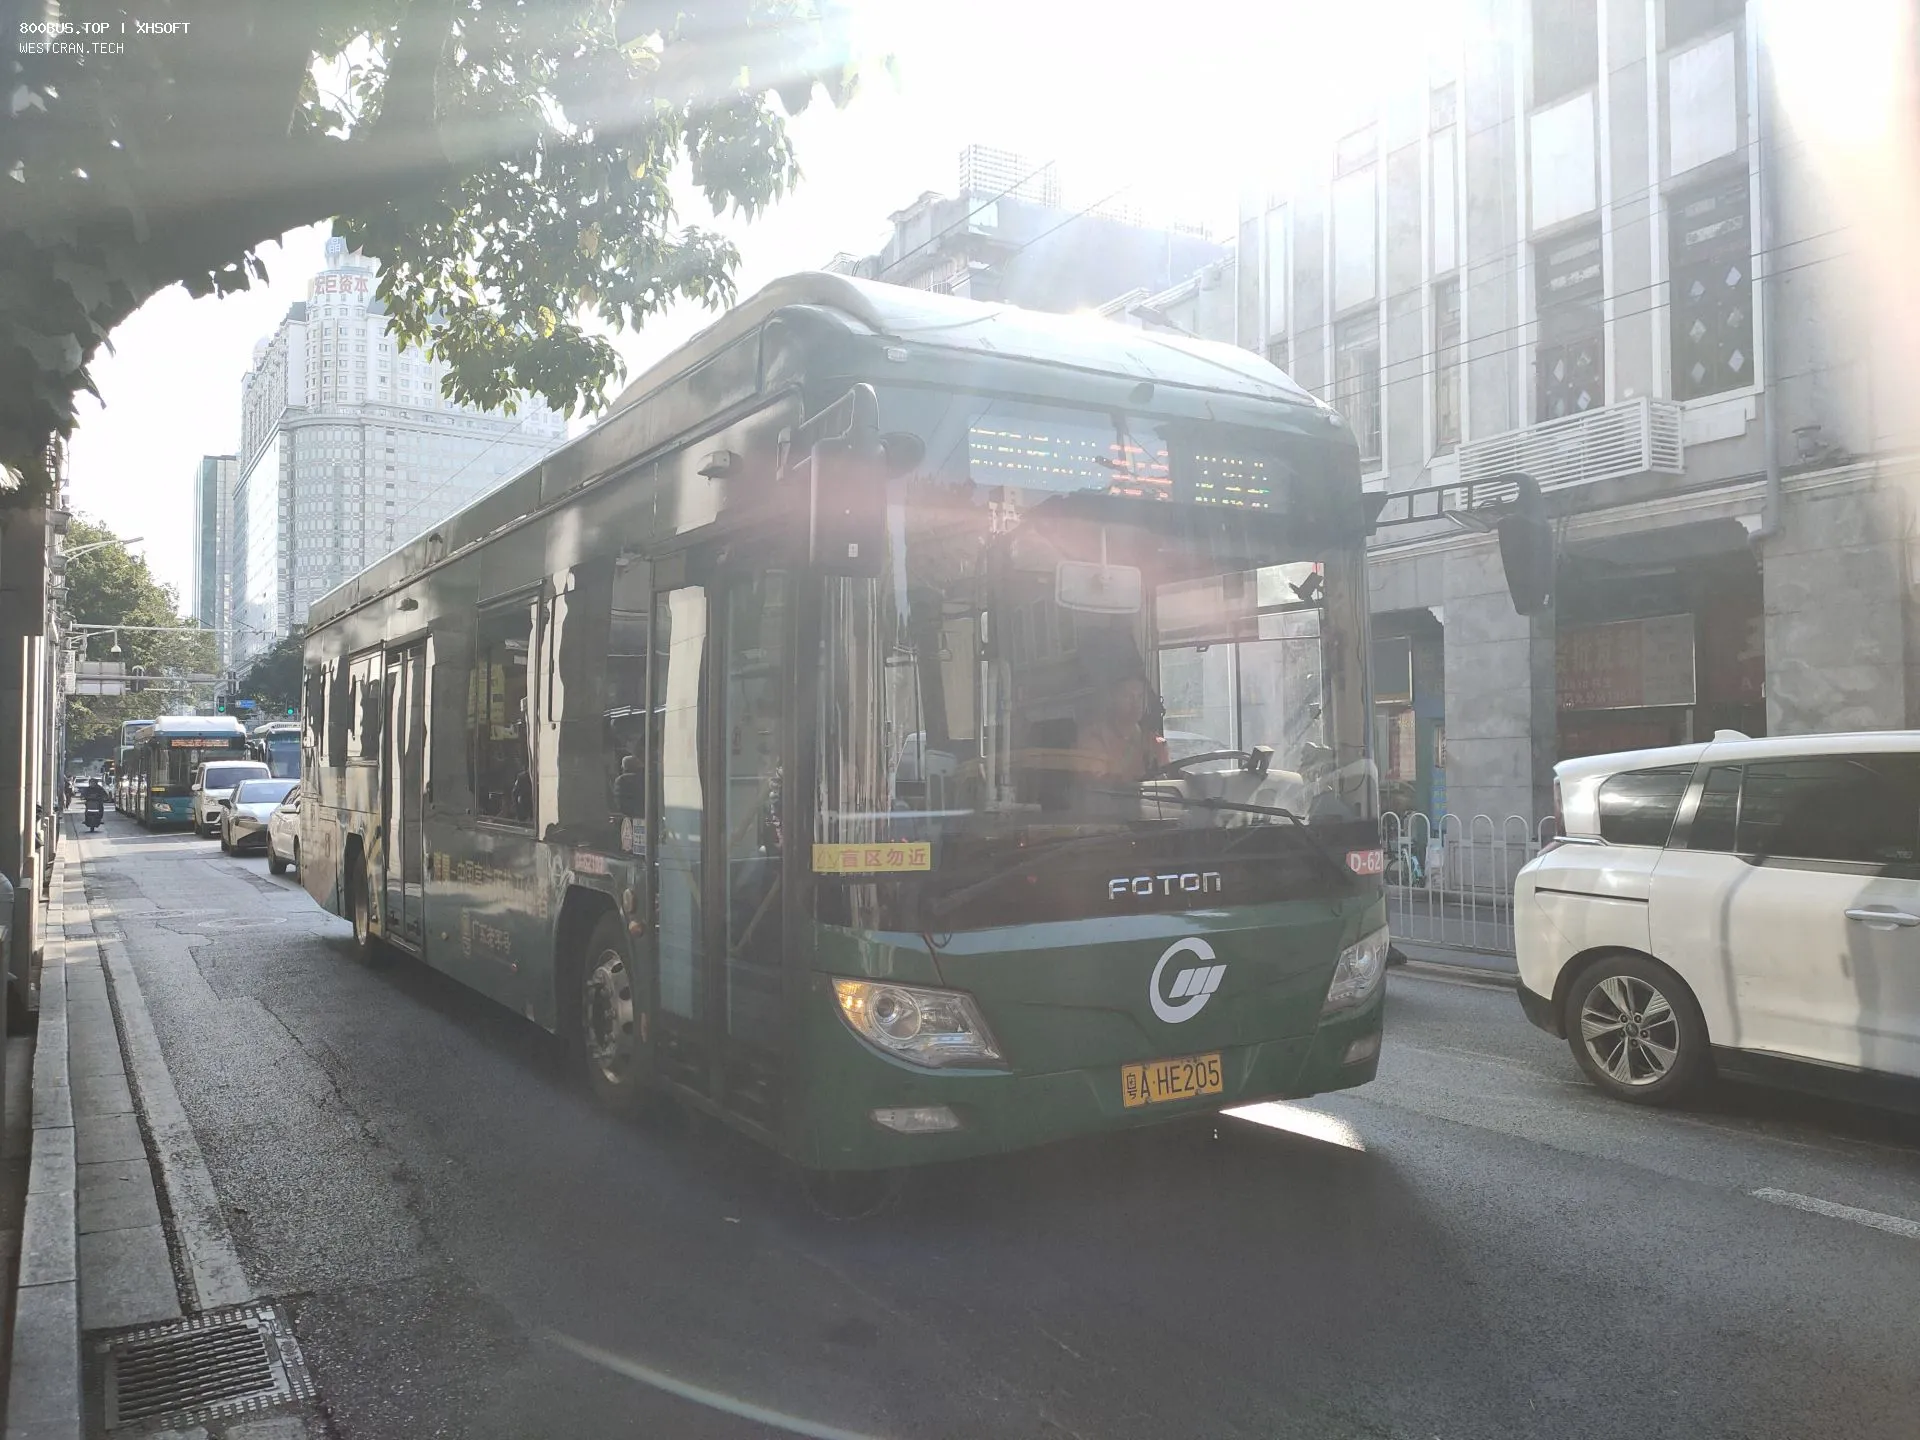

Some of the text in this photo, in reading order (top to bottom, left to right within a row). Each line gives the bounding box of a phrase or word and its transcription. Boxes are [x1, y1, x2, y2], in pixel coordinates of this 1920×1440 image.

[839, 848, 926, 868] 盲区勿近
[1108, 871, 1221, 900] FOTON
